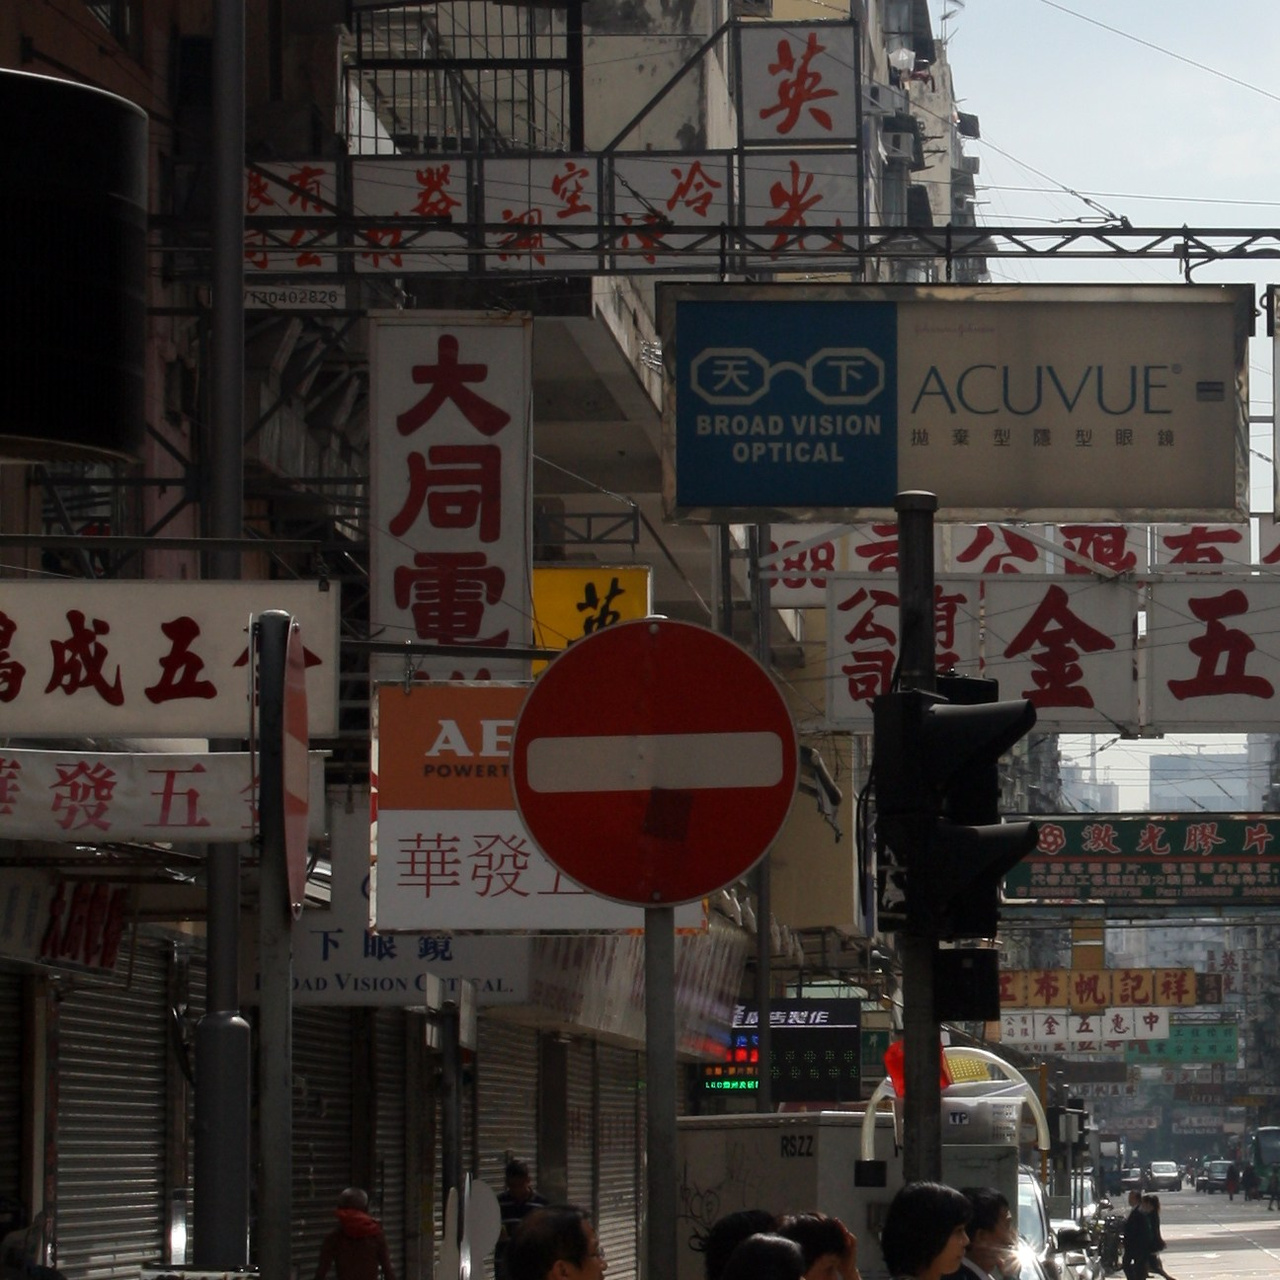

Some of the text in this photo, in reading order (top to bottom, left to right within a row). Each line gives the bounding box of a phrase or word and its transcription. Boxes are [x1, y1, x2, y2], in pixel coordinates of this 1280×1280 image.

[911, 364, 1173, 415] ACUVUE
[696, 414, 882, 436] BROAD VISION
[732, 441, 845, 464] OPTICAL
[389, 334, 513, 682] 大同電
[334, 973, 408, 992] VISION
